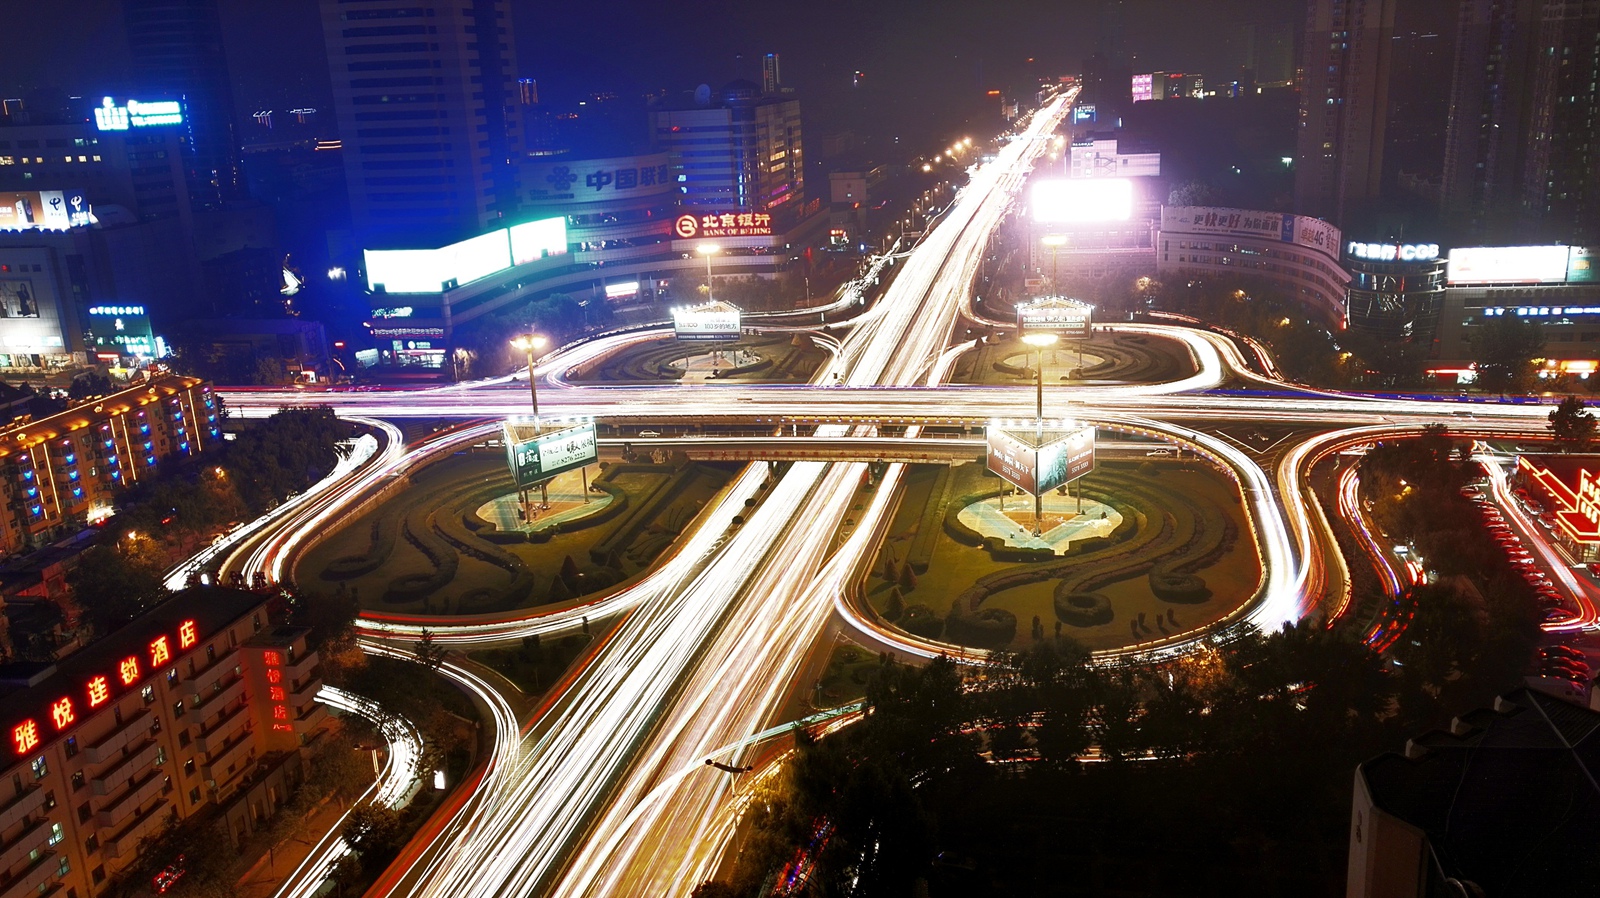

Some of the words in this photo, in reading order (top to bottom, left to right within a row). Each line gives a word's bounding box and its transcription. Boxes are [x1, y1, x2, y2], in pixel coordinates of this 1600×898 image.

[586, 164, 669, 191] 中国联通
[702, 213, 771, 228] 北京银行
[1193, 212, 1242, 229] 更快更好
[727, 228, 738, 236] OF
[740, 227, 772, 235] BEIJING
[1401, 243, 1440, 261] CGB
[13, 620, 196, 754] 雅悦连锁酒店
[264, 651, 287, 720] 雅悦酒店
